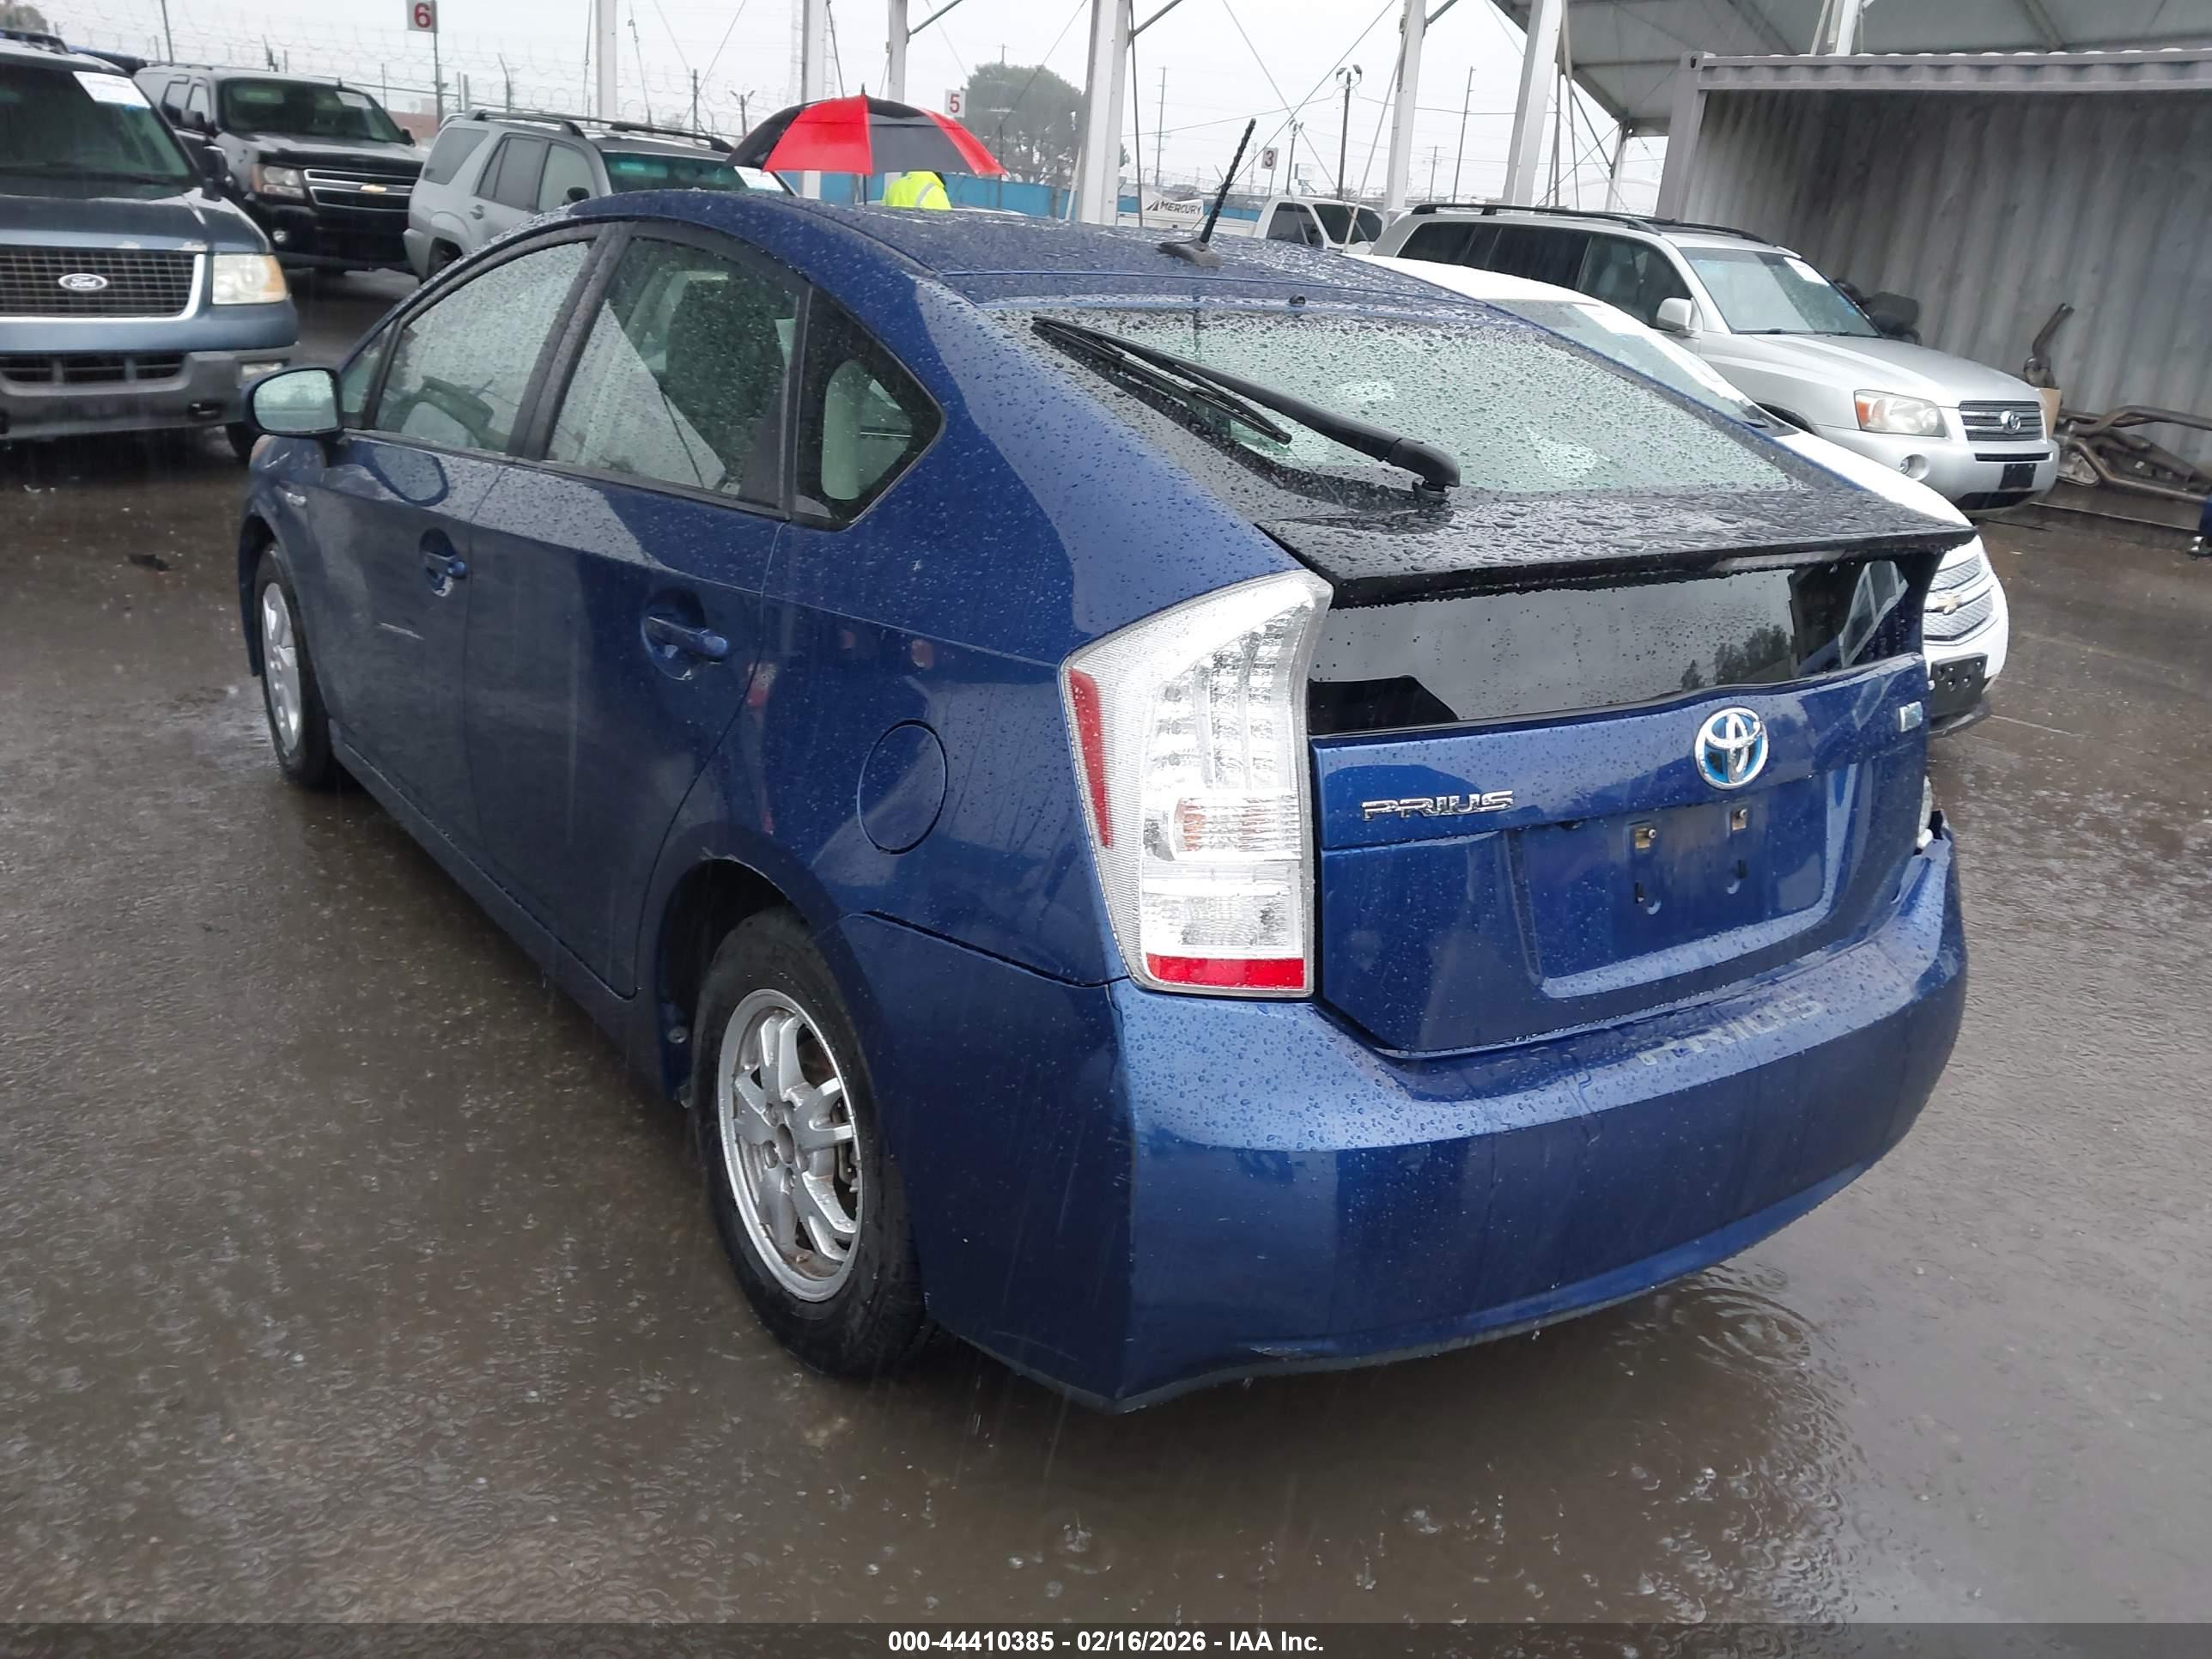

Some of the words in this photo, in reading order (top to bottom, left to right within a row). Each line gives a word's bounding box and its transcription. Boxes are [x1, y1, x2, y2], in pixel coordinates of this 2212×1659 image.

[414, 3, 431, 28] 6
[949, 93, 960, 113] 5
[1264, 150, 1274, 167] 3
[1159, 200, 1201, 215] MERCURY
[1362, 790, 1513, 821] PRIUS
